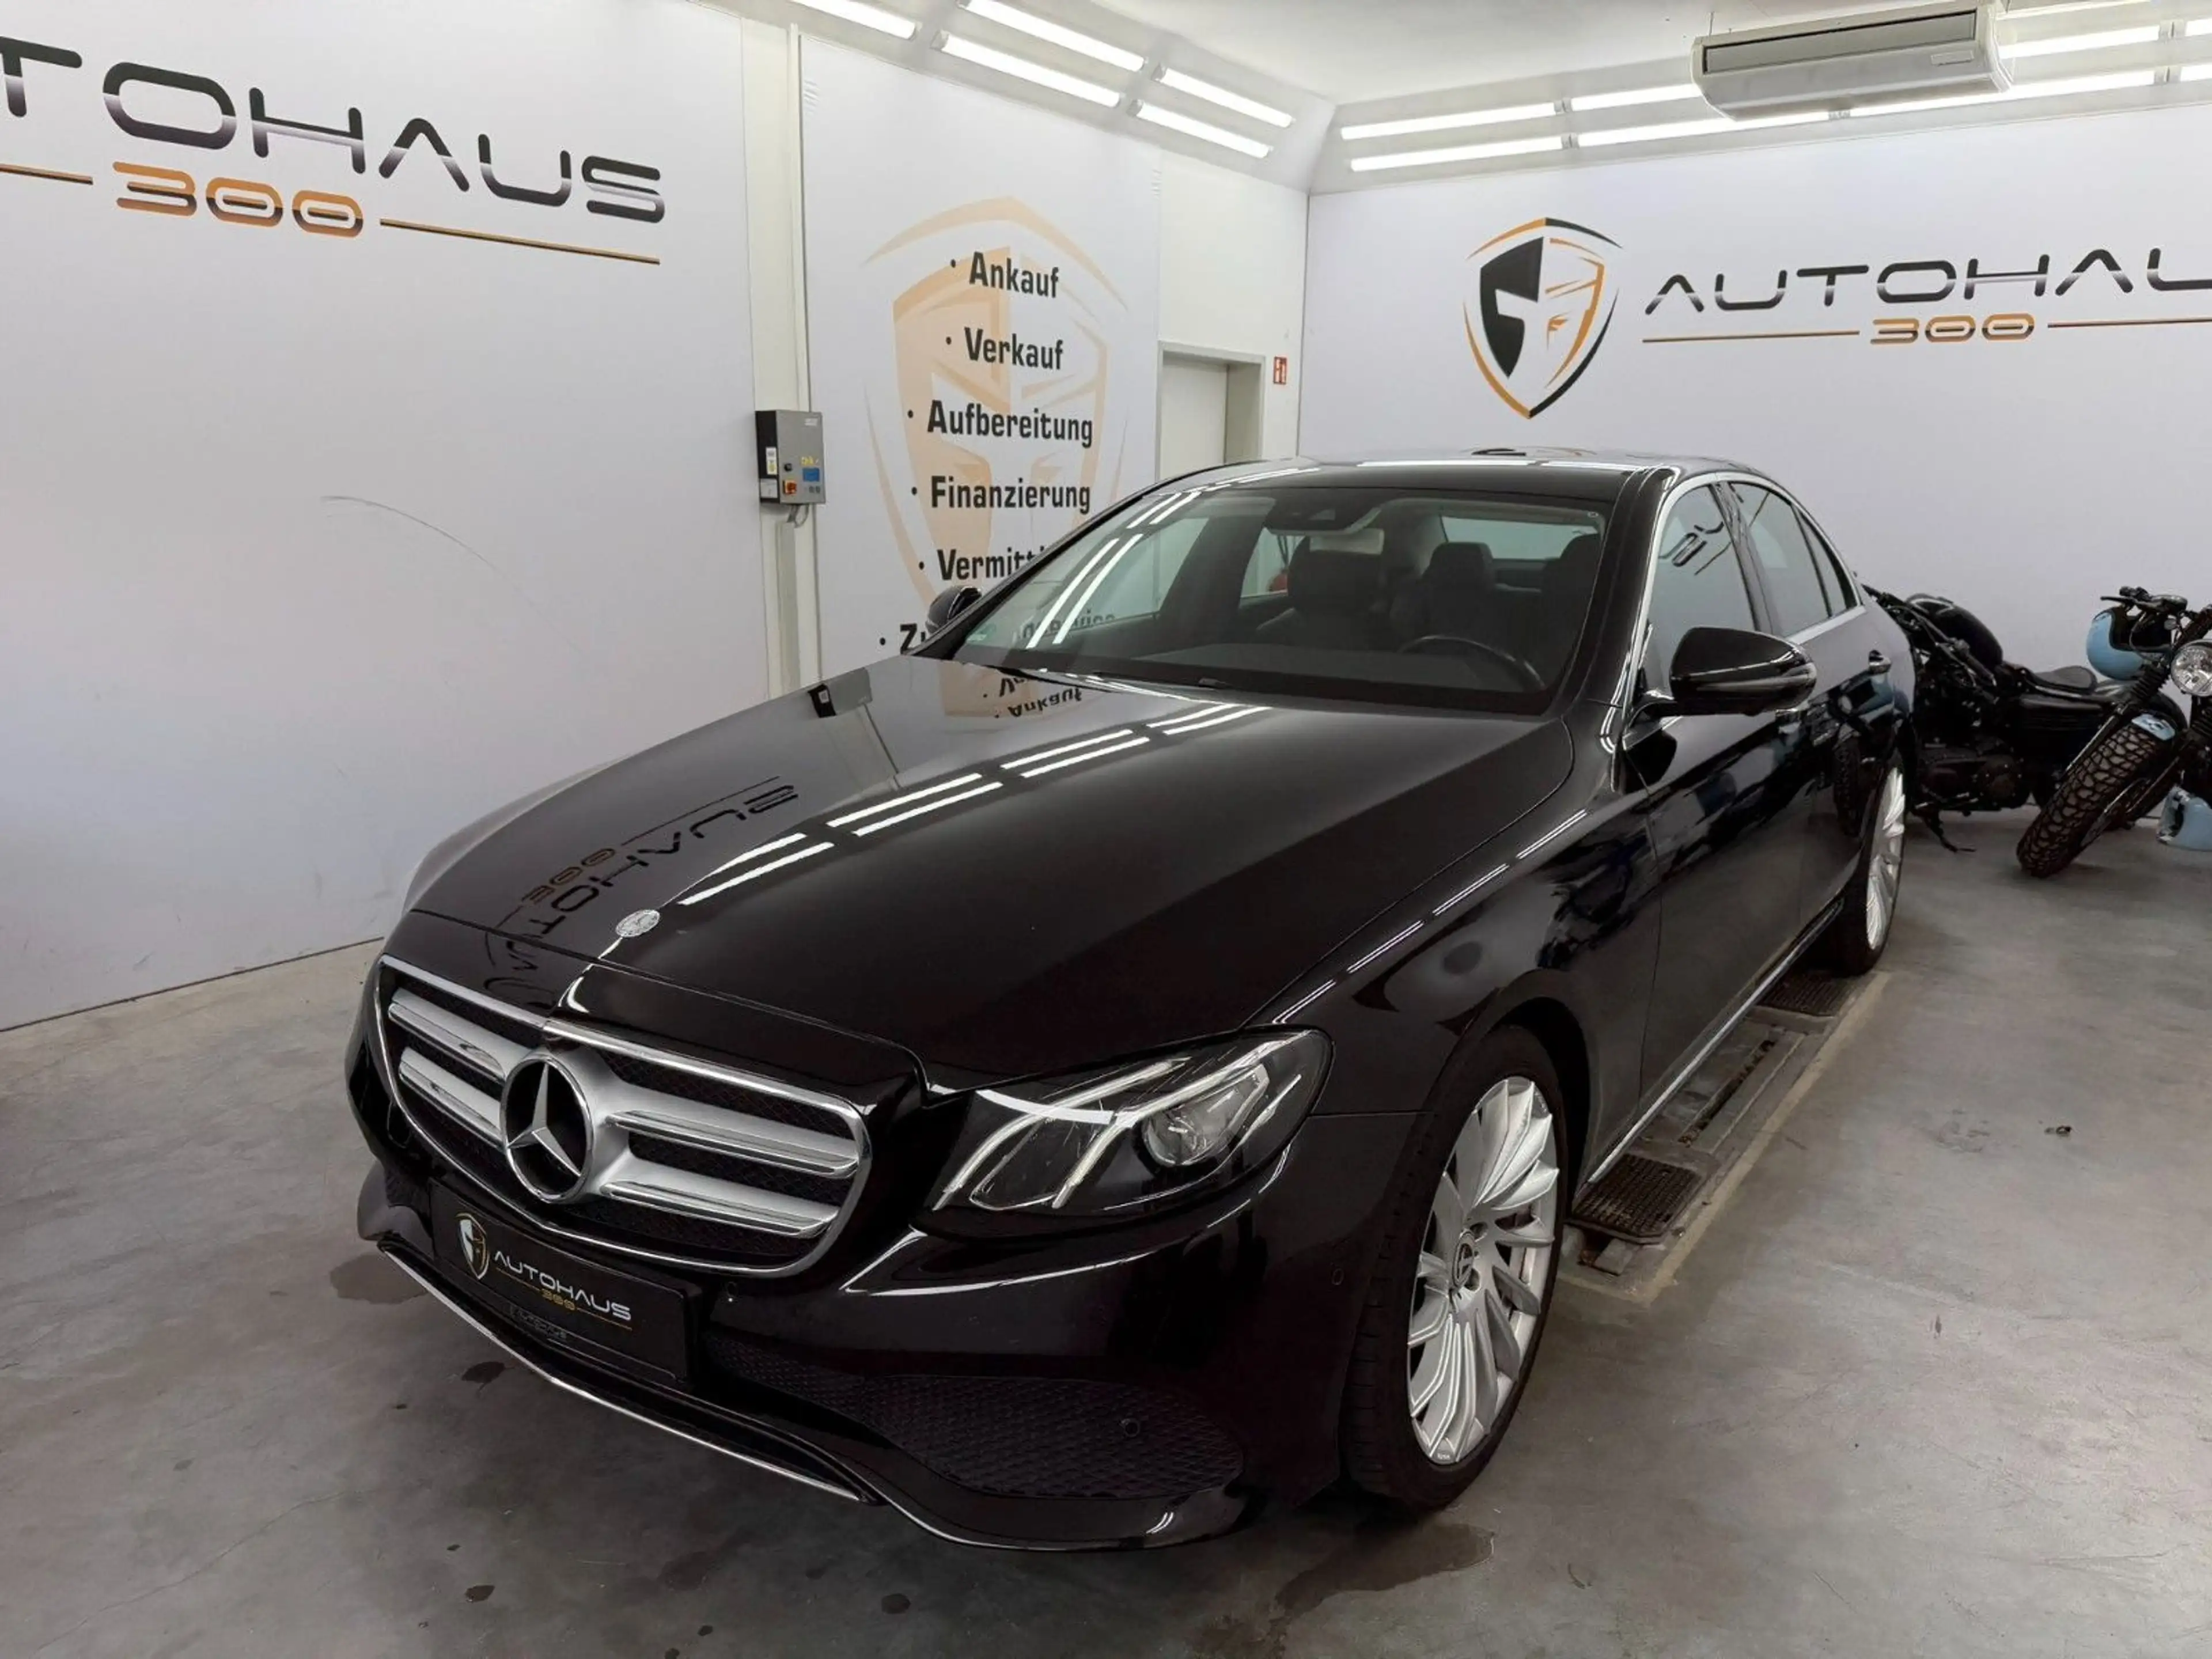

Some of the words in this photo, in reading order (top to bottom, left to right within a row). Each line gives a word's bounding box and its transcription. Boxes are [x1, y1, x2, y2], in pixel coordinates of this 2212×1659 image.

[112, 162, 364, 238] 300
[969, 251, 1059, 298] Ankauf
[964, 326, 1063, 370] Verkauf
[1870, 313, 2035, 346] 300
[927, 399, 1093, 448] Aufbereitung
[930, 475, 1090, 514] Finanzierung
[494, 1250, 632, 1321] AUTOHAUS
